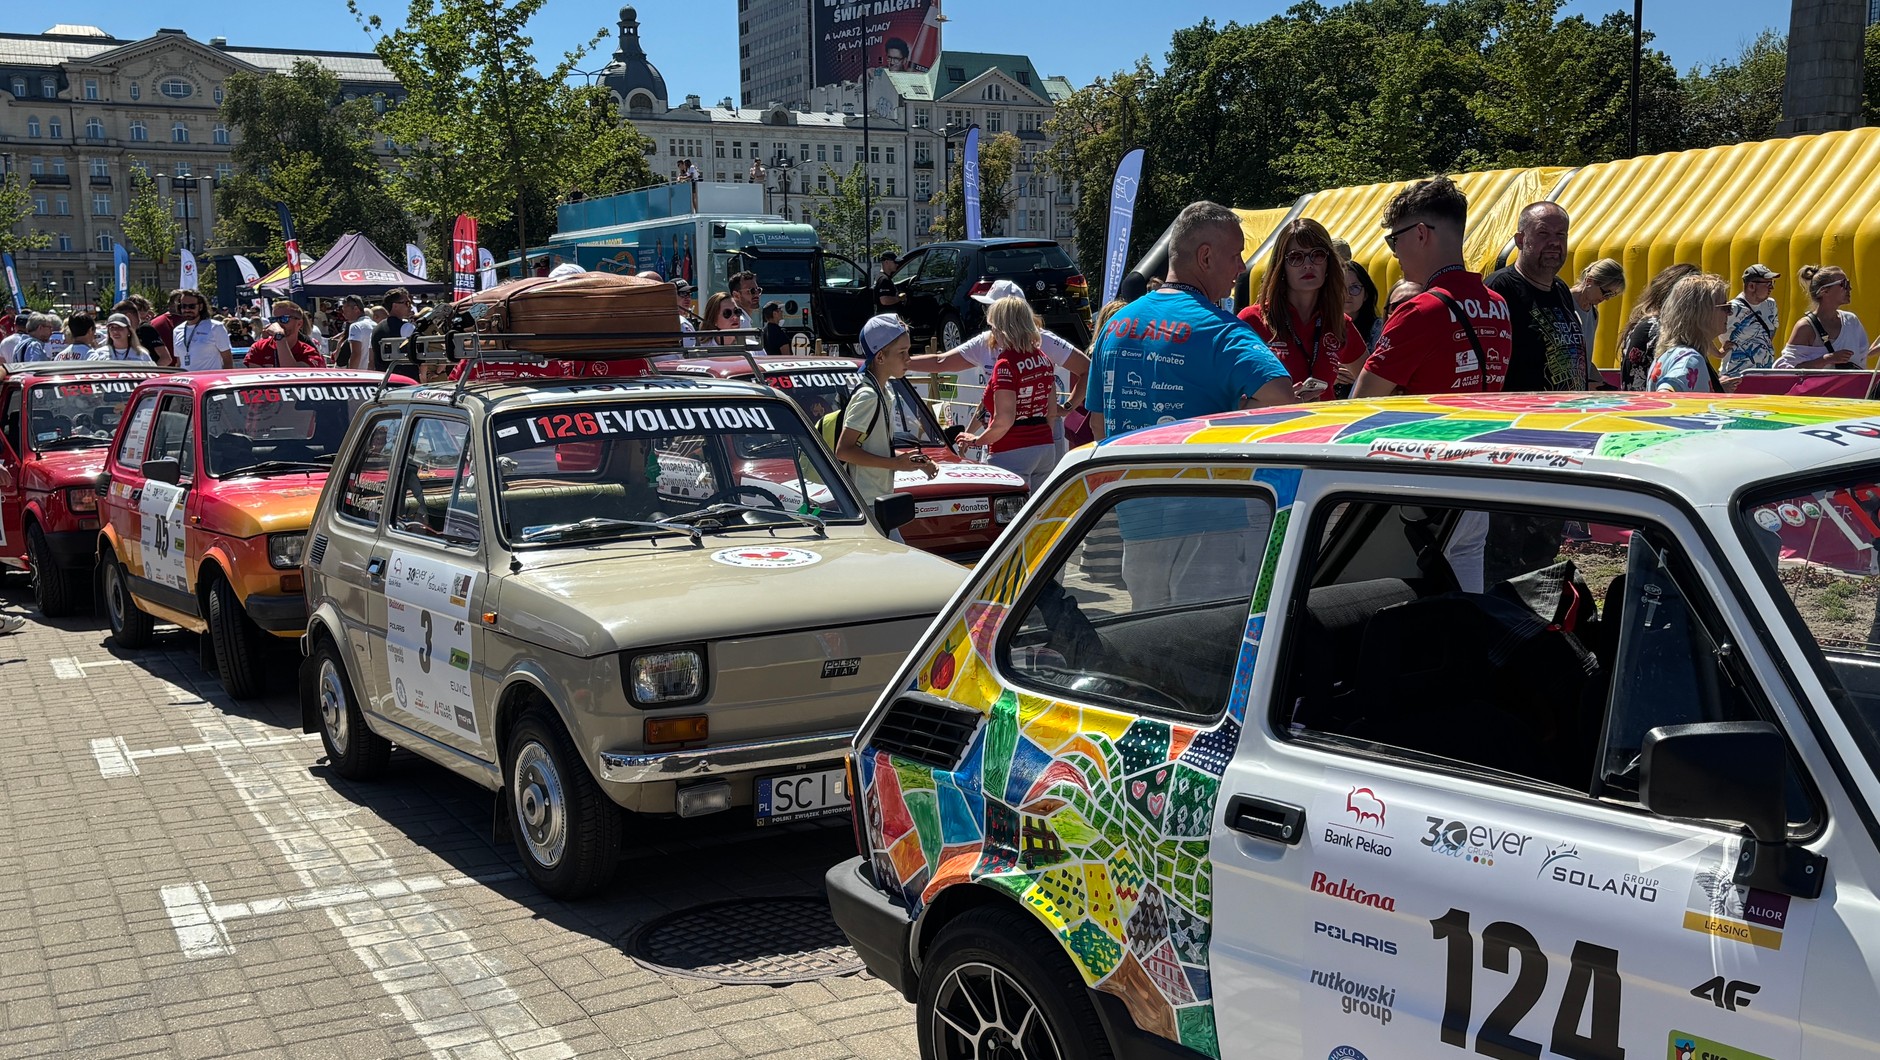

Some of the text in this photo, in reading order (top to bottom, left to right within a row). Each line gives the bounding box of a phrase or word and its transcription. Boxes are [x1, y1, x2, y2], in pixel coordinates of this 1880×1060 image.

[832, 21, 891, 39] WARSZWIACY
[1106, 317, 1192, 344] POLAND
[769, 361, 848, 369] POLAND
[75, 371, 160, 380] POLAND
[258, 371, 358, 379] POLAND
[567, 382, 712, 394] POLAND
[1151, 381, 1184, 391] Baltona
[960, 503, 989, 512] donateo
[419, 609, 432, 674] 3
[824, 667, 857, 677] FIAT
[758, 802, 770, 812] PL
[771, 815, 792, 823] POLSKI
[1324, 828, 1392, 858] Bank Pekao
[1467, 846, 1494, 858] GRUPA
[1552, 866, 1657, 903] SOLANO
[1623, 873, 1660, 887] GROUP
[1310, 871, 1396, 913] Baltona
[1747, 904, 1783, 921] ALIOR
[1704, 920, 1749, 939] LEASING
[1314, 921, 1398, 956] POLARIS
[1310, 969, 1396, 1008] rutkowski
[1430, 908, 1625, 1060] 124
[1341, 994, 1392, 1026] group
